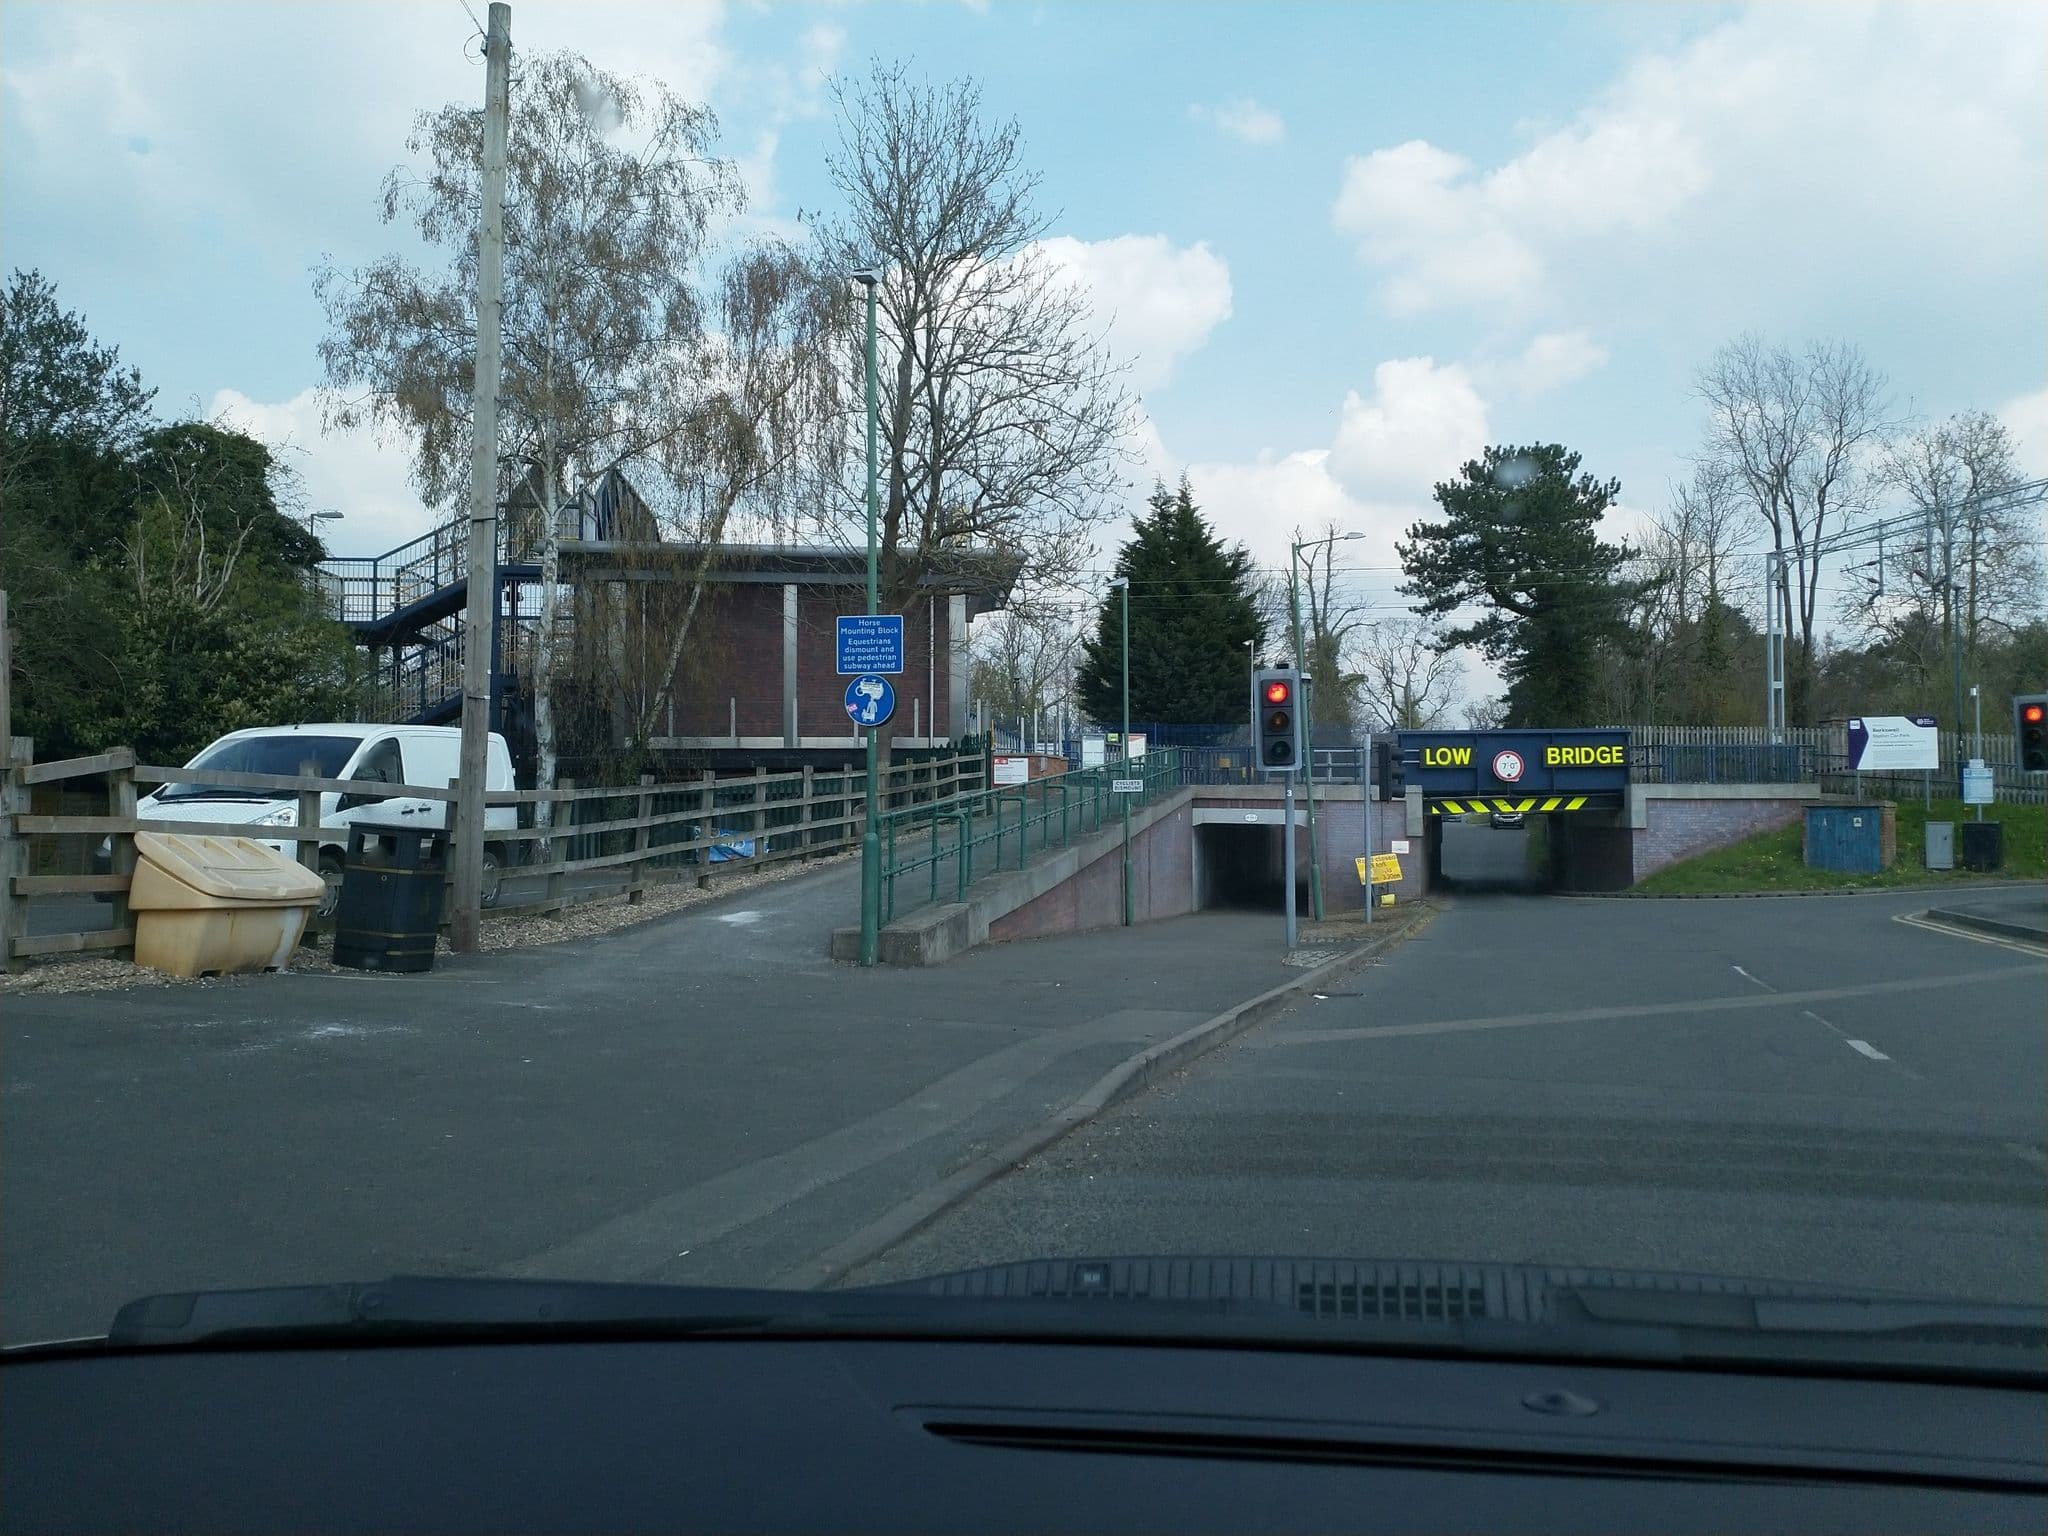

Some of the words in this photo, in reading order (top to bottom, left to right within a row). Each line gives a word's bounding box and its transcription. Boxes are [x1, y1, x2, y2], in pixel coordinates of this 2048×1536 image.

[840, 627, 875, 635] Mounting
[847, 638, 892, 646] Equestrians
[844, 646, 879, 654] dismount
[880, 645, 895, 653] and
[857, 654, 897, 662] pedestrian
[1425, 747, 1471, 765] LOW
[1546, 746, 1625, 765] BRIDGE
[1286, 789, 1293, 797] 3
